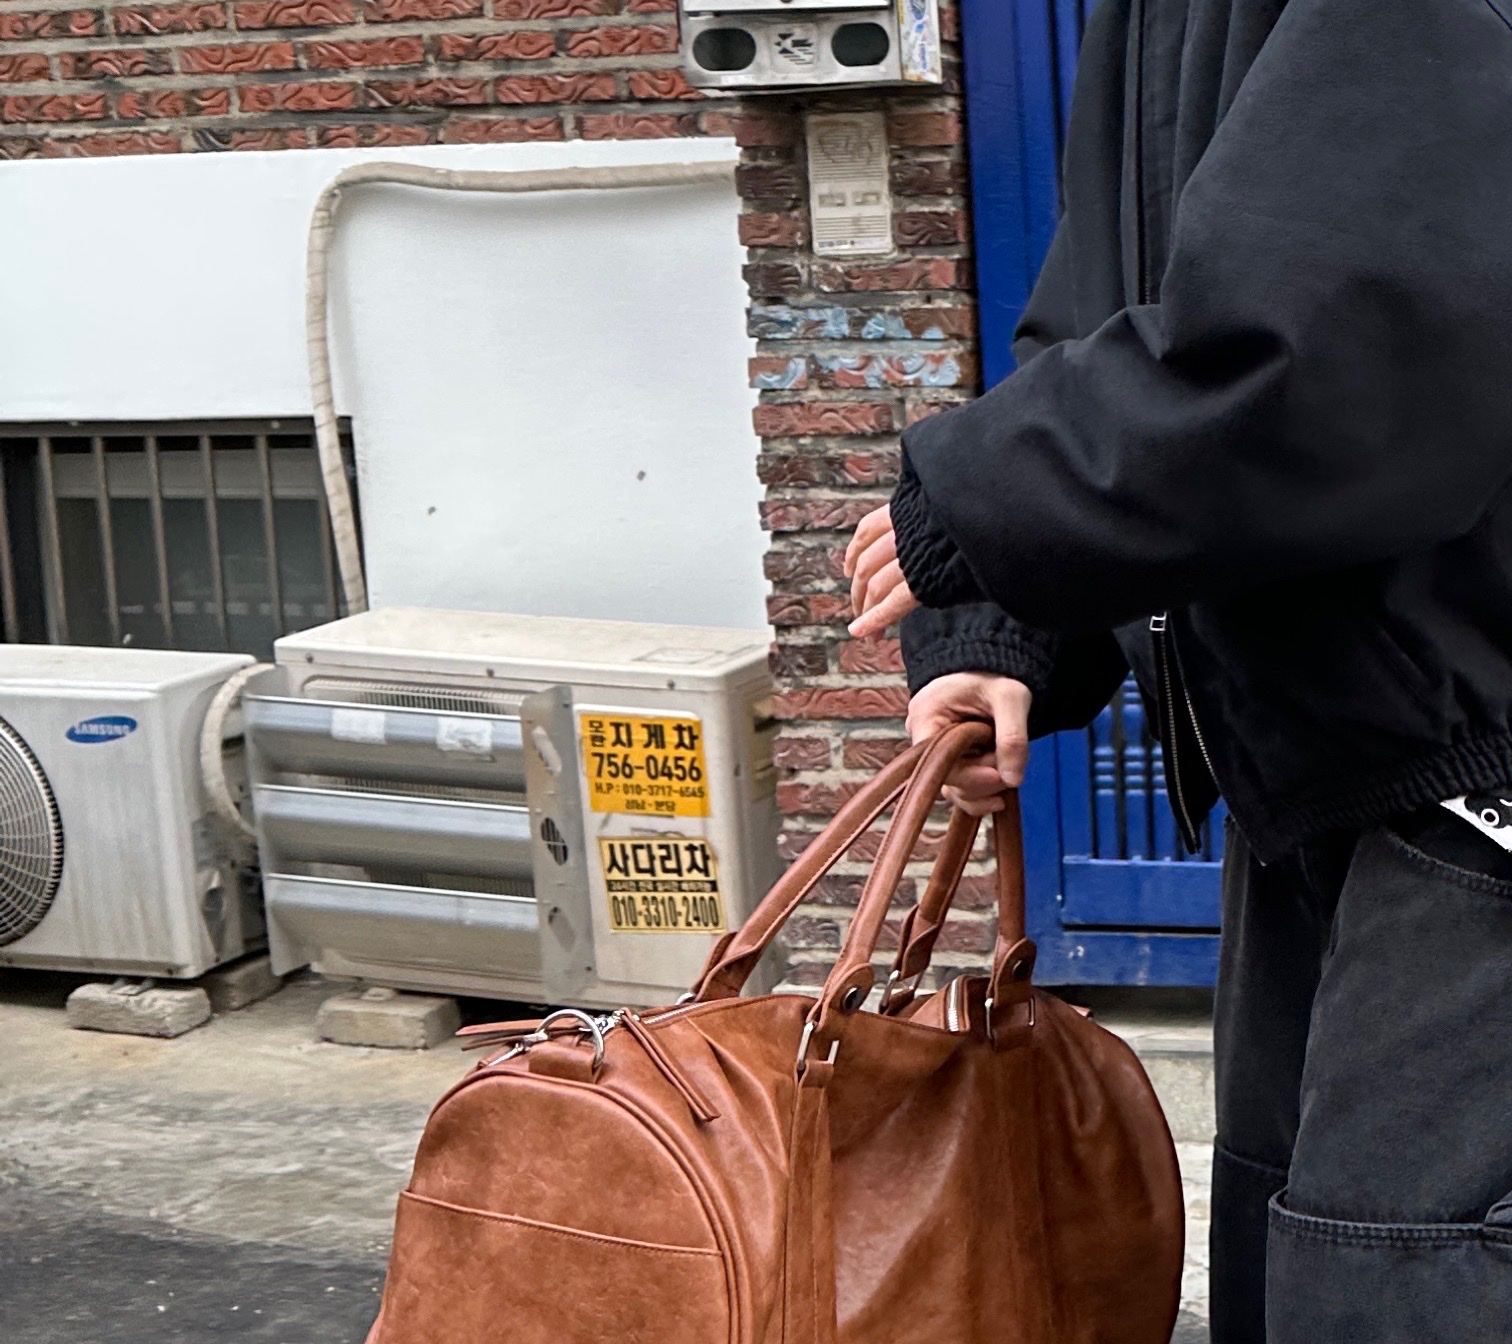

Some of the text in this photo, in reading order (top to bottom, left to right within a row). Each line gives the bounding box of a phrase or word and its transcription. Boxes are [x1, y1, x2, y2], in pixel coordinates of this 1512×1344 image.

[73, 723, 129, 736] SAMSUNG
[591, 752, 702, 783] 756-0456
[606, 843, 711, 878] 사다리차
[612, 895, 719, 928] 010-3310-2400
